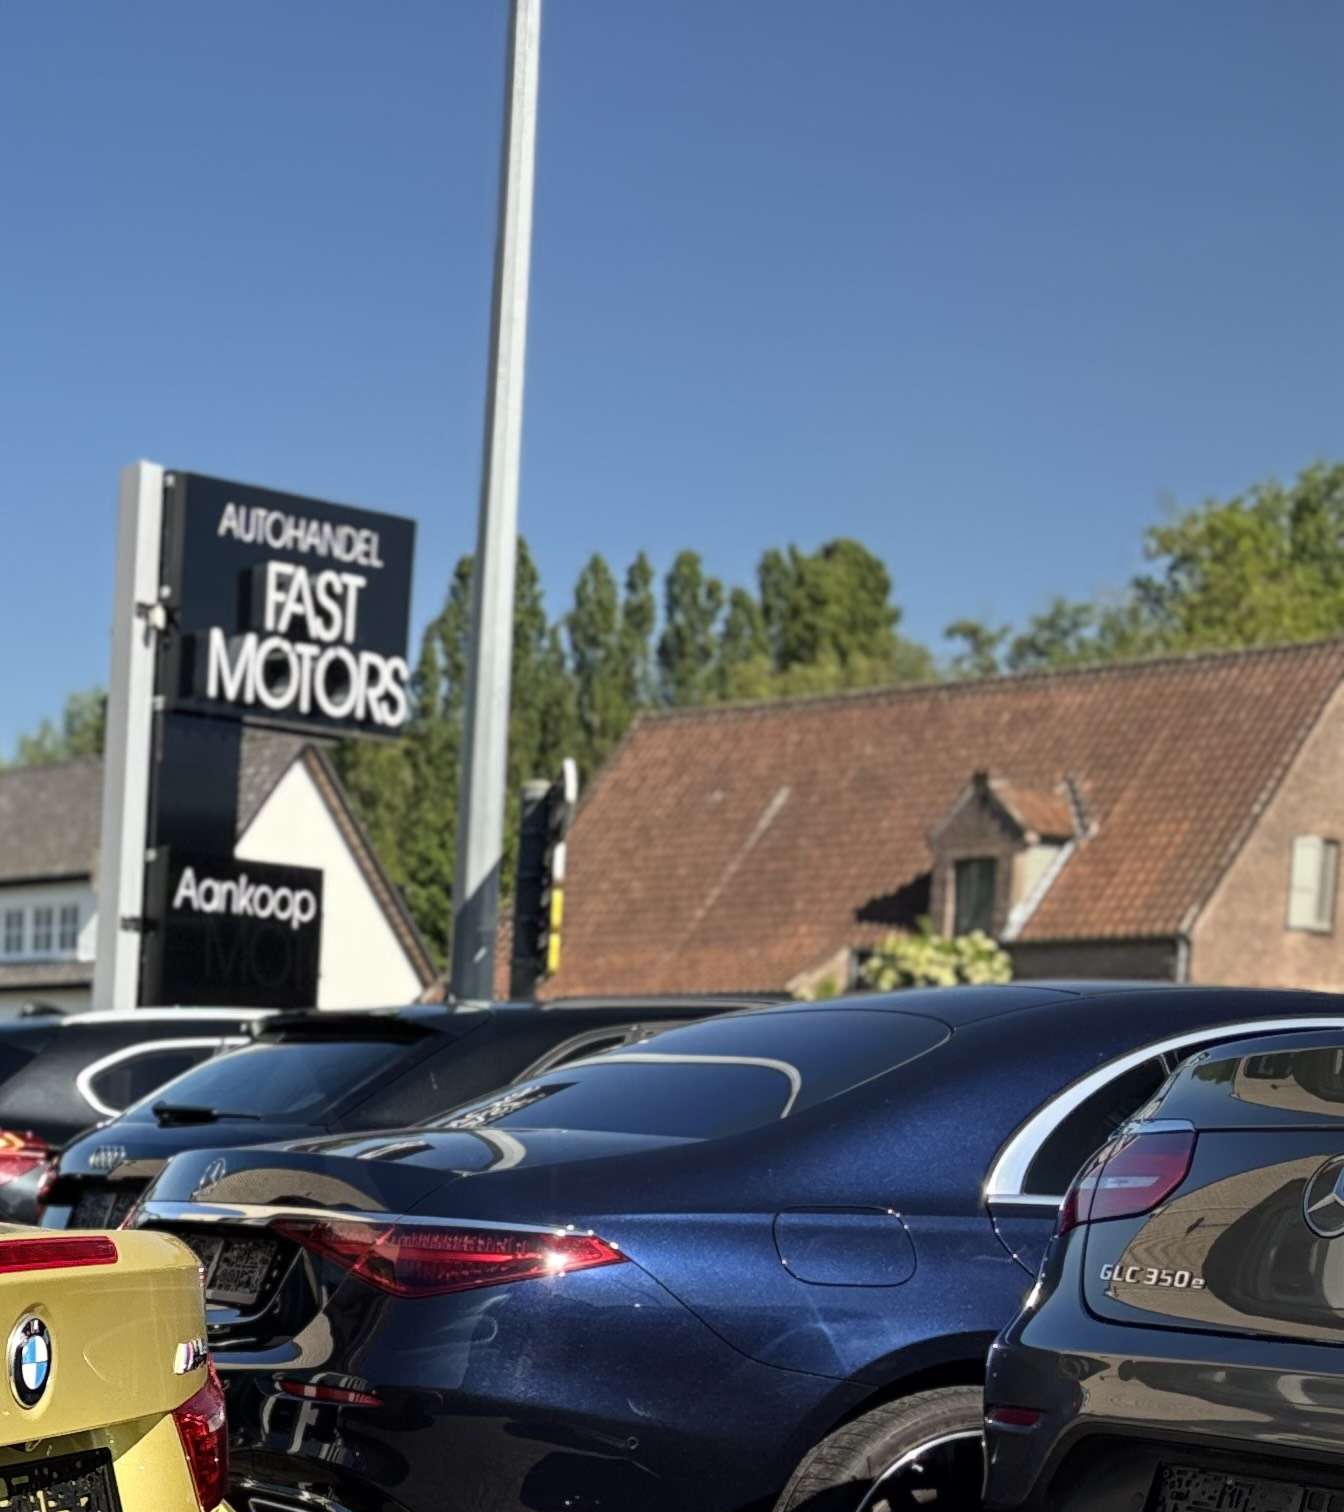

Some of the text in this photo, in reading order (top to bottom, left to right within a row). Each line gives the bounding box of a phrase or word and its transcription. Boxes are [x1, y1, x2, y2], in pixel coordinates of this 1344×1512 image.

[217, 502, 385, 568] AUTOHANDEL
[264, 559, 367, 645] FAST
[206, 626, 410, 727] MOTORS
[172, 866, 317, 930] Aankoop
[1099, 1264, 1141, 1283] GLC
